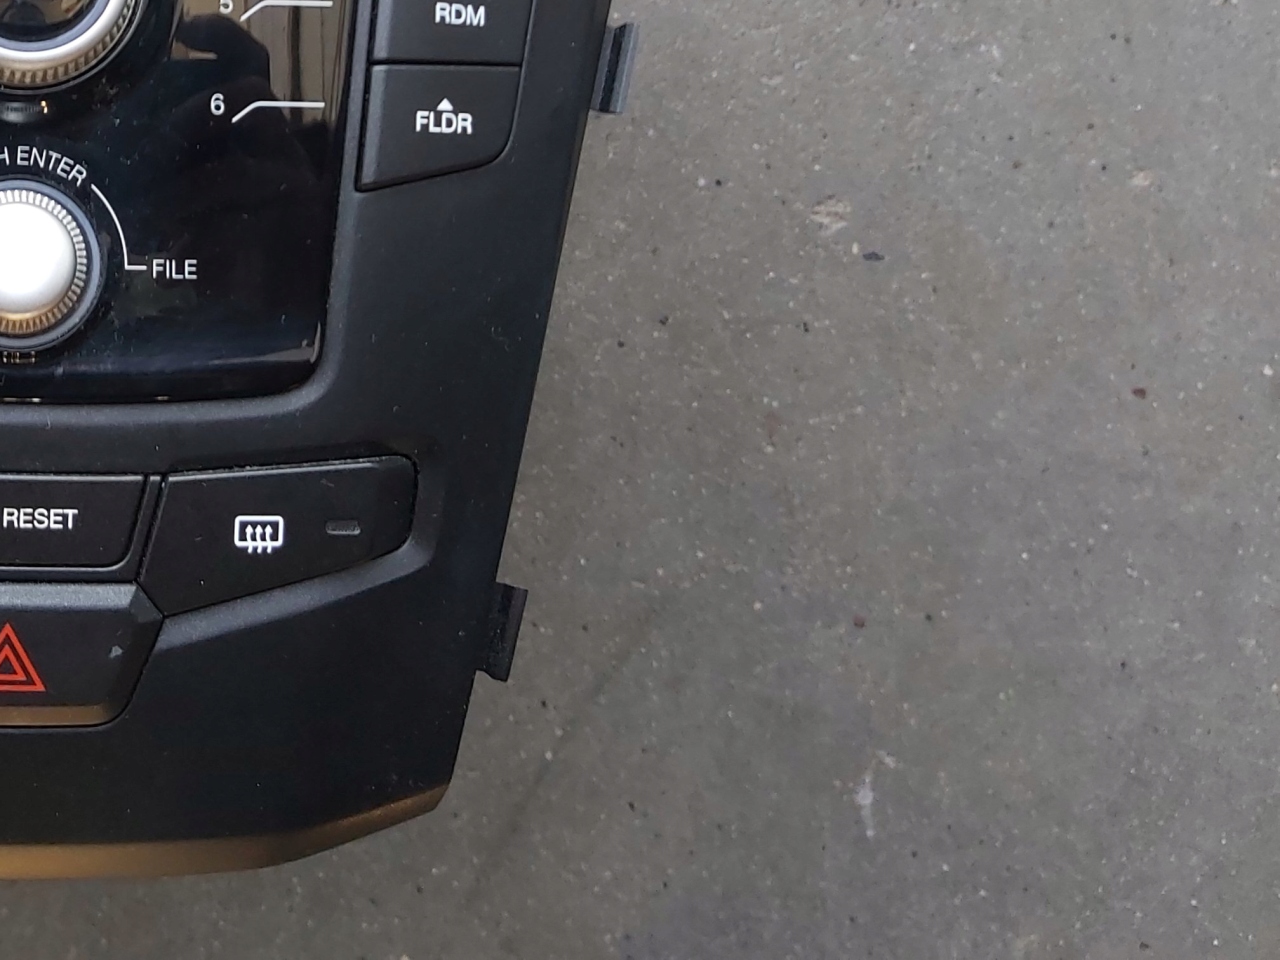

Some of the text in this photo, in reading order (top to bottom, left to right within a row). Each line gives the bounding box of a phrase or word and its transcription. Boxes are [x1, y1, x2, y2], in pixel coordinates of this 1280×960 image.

[435, 1, 485, 27] RDM
[210, 93, 225, 116] 6
[415, 110, 473, 135] FLDR
[16, 145, 87, 187] ENTER
[152, 258, 197, 280] FILE
[2, 507, 79, 530] RESET
